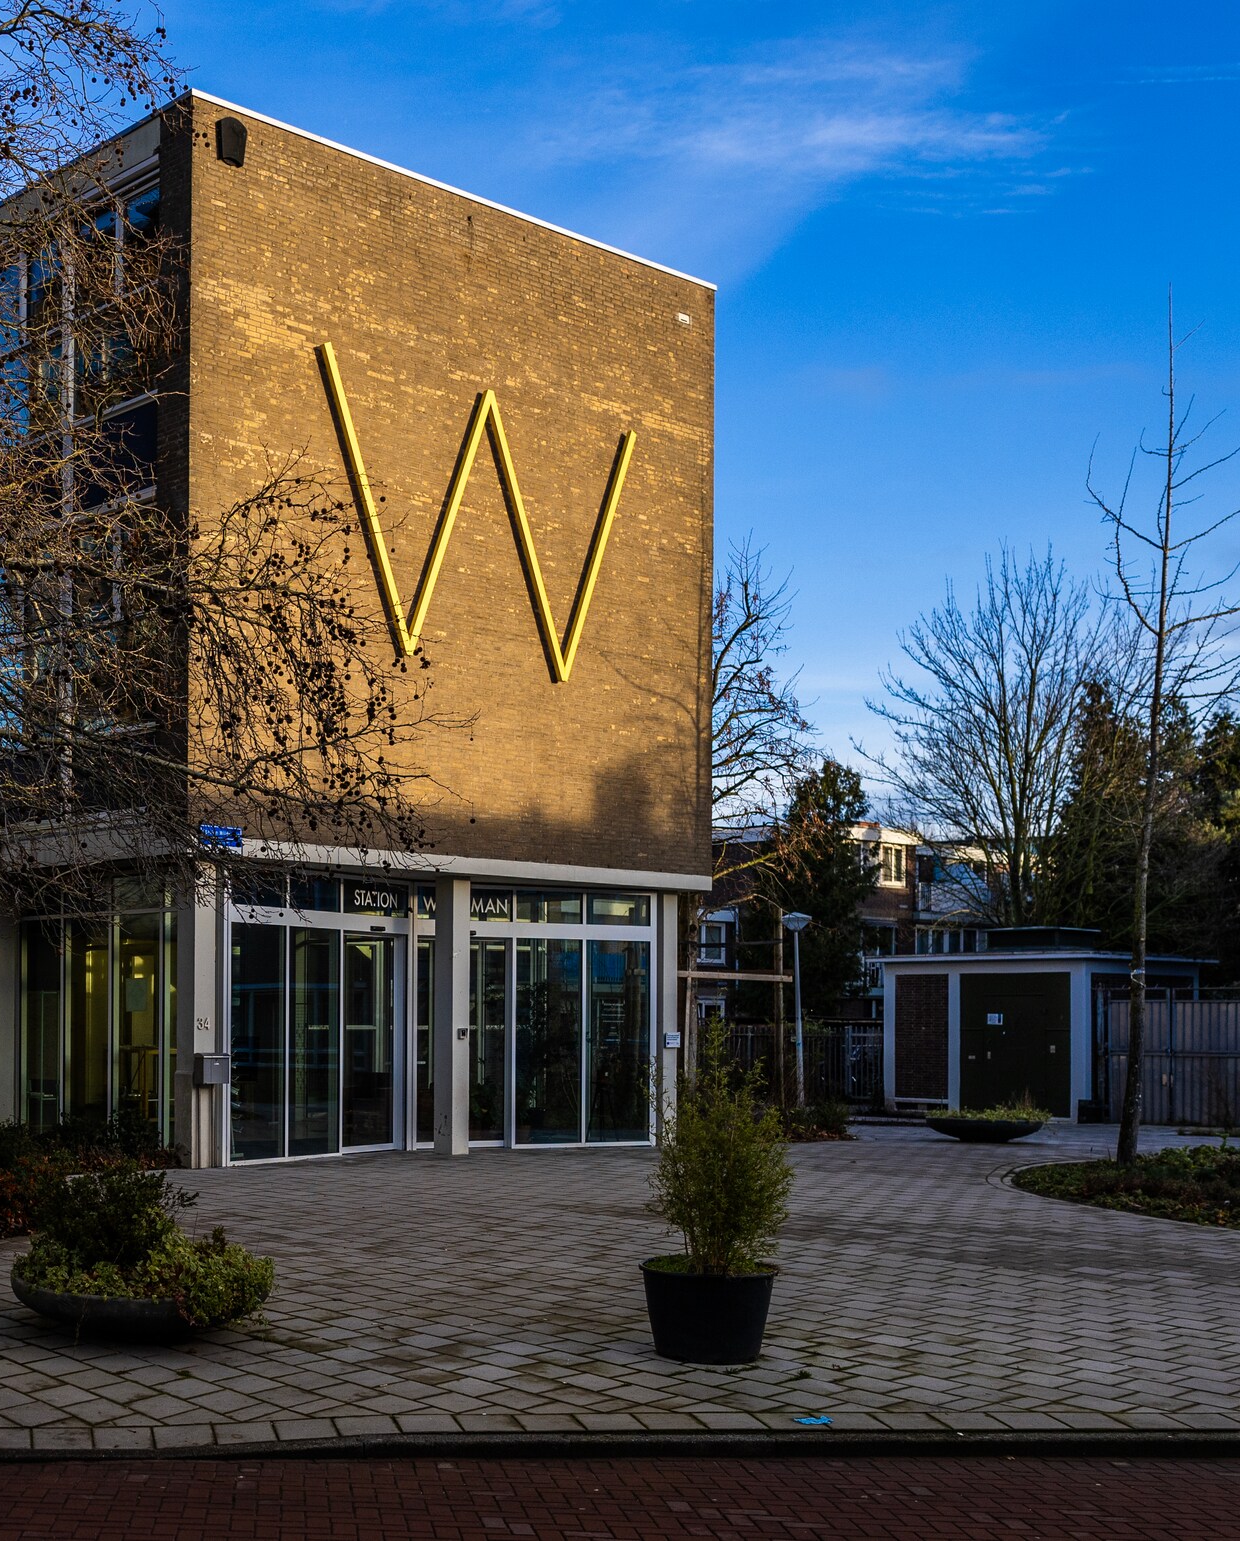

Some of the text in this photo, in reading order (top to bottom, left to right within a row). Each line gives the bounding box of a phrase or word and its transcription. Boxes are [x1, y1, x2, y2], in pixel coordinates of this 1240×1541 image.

[319, 341, 637, 682] W
[354, 889, 398, 908] STATION
[196, 1016, 210, 1030] 34
